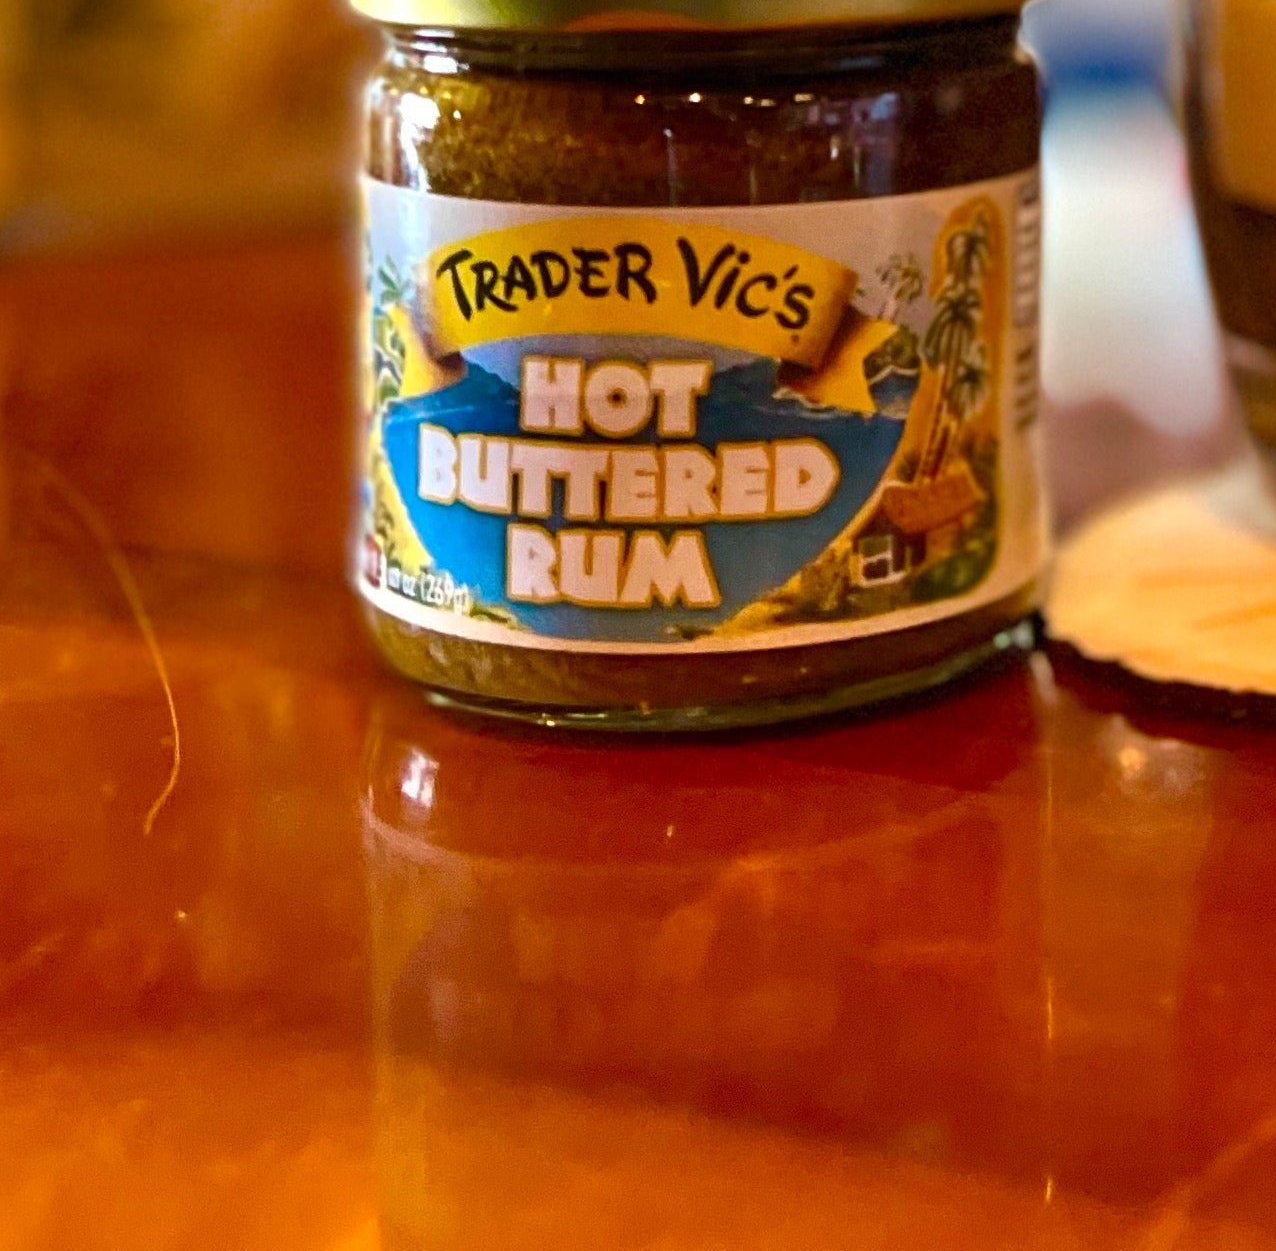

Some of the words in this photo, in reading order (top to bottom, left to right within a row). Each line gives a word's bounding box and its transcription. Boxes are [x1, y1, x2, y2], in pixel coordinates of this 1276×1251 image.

[436, 241, 658, 322] TRADER
[519, 354, 714, 438] HOT
[417, 423, 842, 523] BUTTERED
[505, 523, 722, 611] RUM
